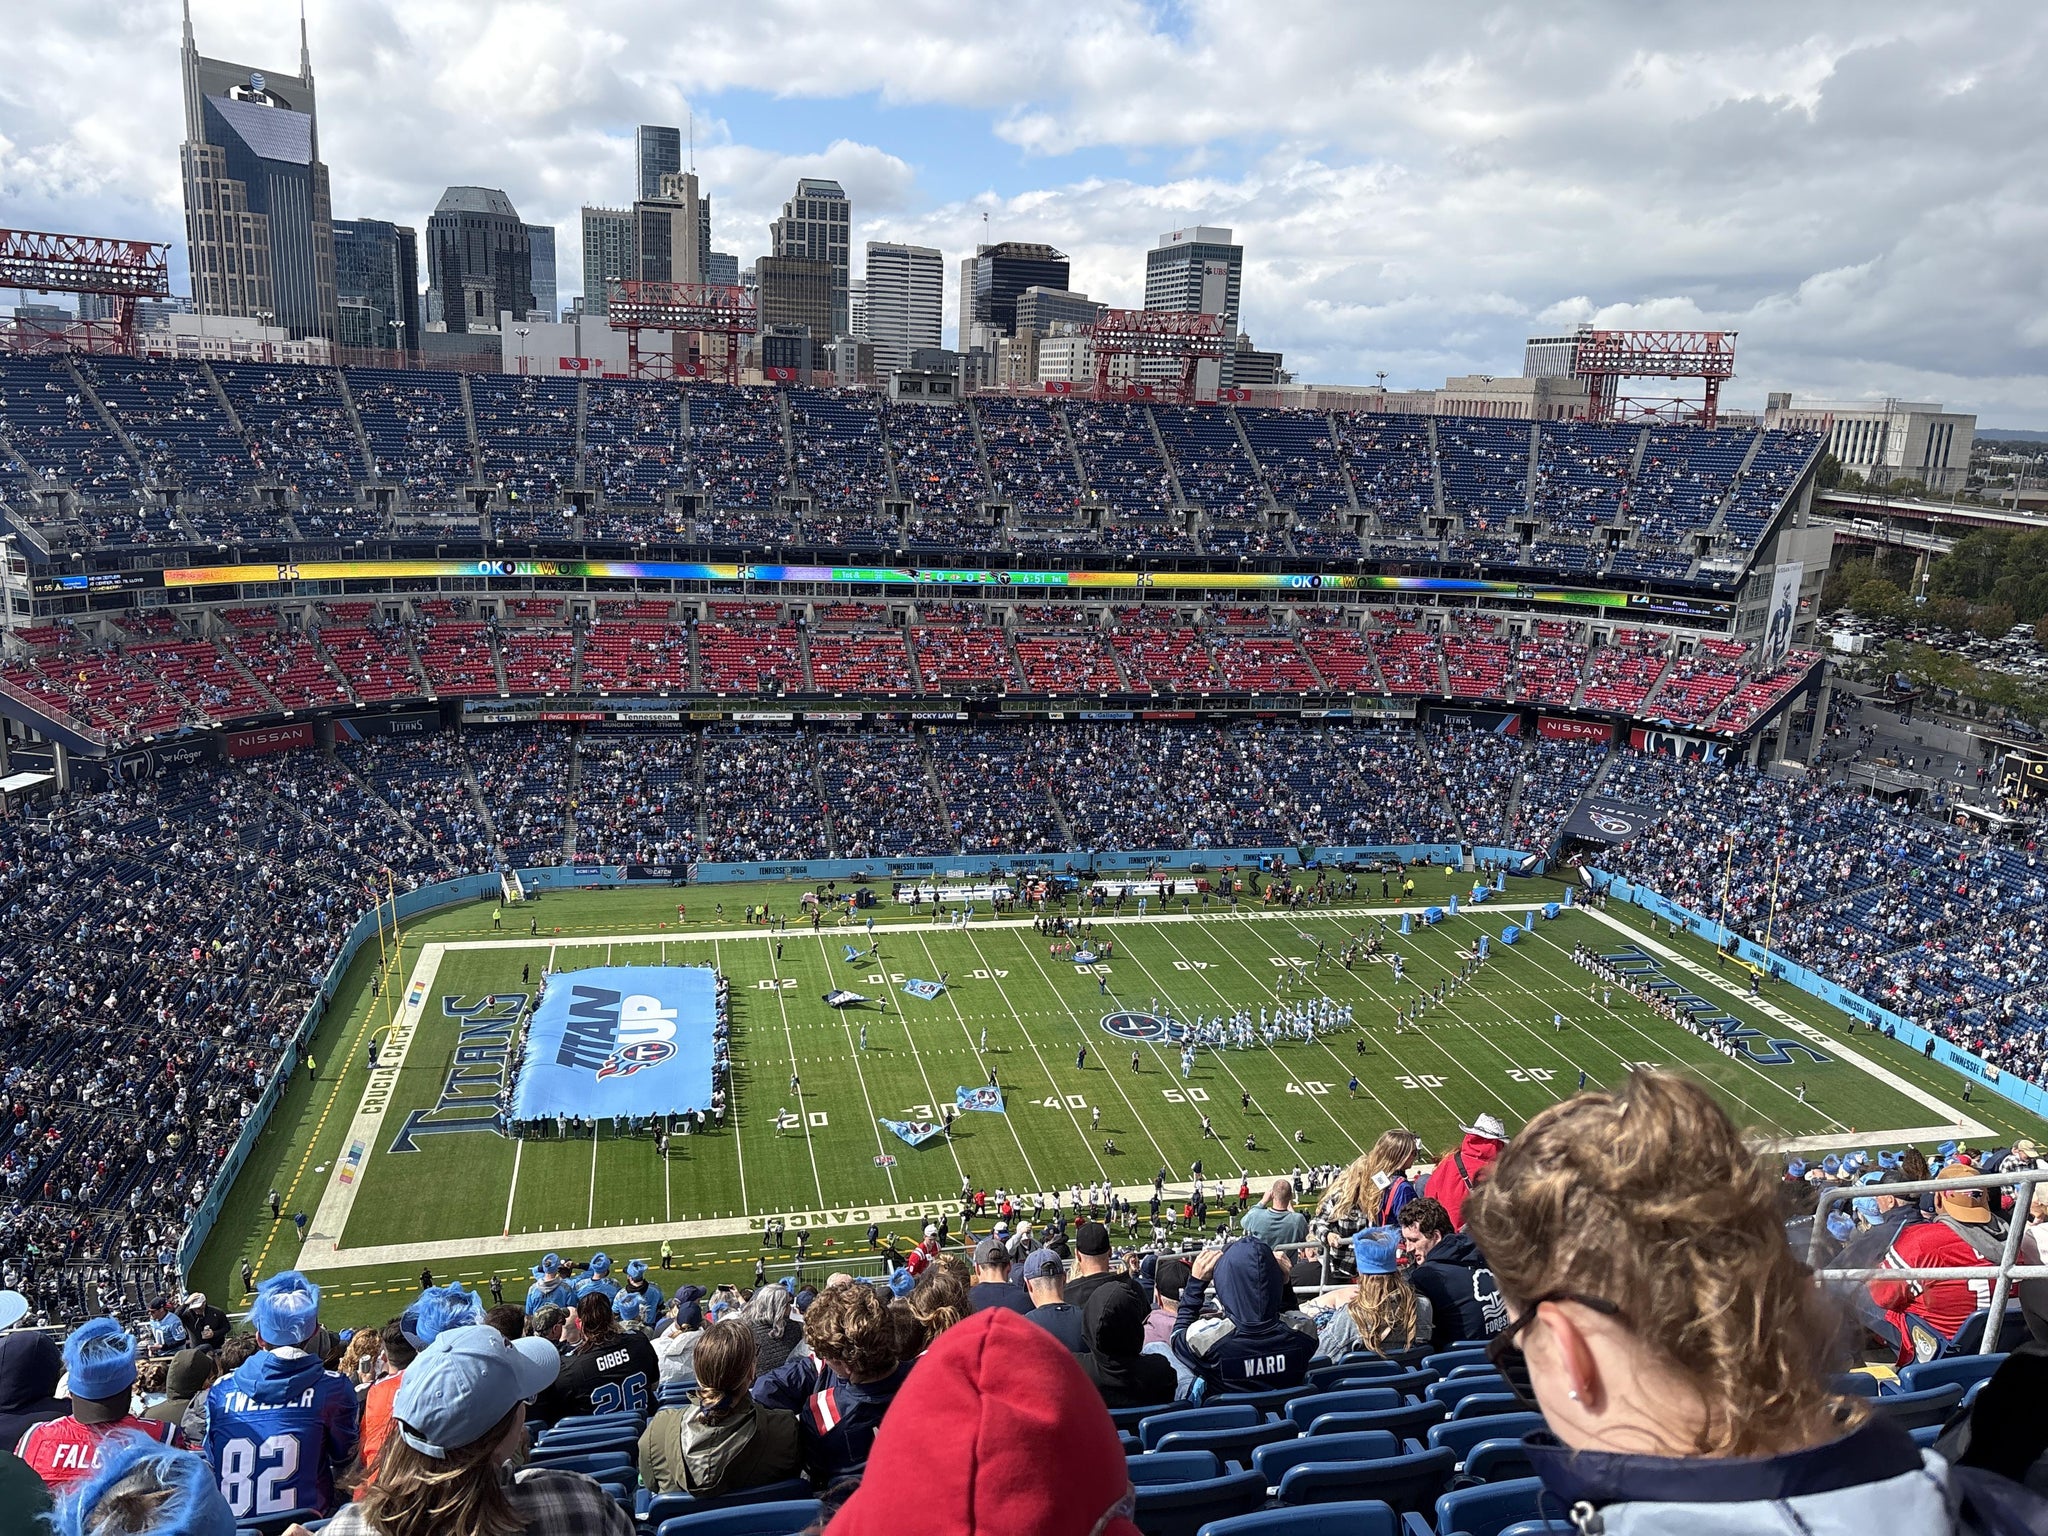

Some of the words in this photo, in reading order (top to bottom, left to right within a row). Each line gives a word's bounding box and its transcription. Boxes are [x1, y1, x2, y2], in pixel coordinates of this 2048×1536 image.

[278, 564, 299, 580] 85
[478, 560, 571, 576] OKONKWO
[737, 564, 756, 580] 85
[936, 572, 944, 581] 0
[966, 573, 974, 582] 0
[1023, 574, 1046, 583] 6:51
[1136, 573, 1154, 588] 85
[1291, 575, 1368, 588] OKONKWO
[35, 584, 53, 592] 11:55
[1516, 584, 1535, 599] 85
[622, 713, 676, 721] Tennessean.
[1443, 714, 1472, 726] TITANS
[389, 719, 423, 733] TITANS
[1546, 721, 1604, 736] NISSAN
[238, 729, 304, 747] NISSAN
[173, 748, 202, 764] Kroger
[1589, 804, 1649, 820] NISSAN
[1576, 833, 1606, 844] NISSAN
[887, 862, 915, 871] TENNESSEE
[916, 861, 934, 870] TOUGH
[1010, 859, 1036, 867] TENNESSEE
[759, 866, 786, 876] TENNESSEE
[1074, 964, 1113, 974] 50
[1172, 960, 1209, 971] 40
[1268, 956, 1307, 967] 30
[867, 973, 907, 984] 30
[972, 969, 1009, 980] 40
[758, 978, 798, 990] 20
[1602, 944, 1834, 1065] TITANS
[1691, 962, 1741, 994] TAKES
[1739, 992, 1772, 1012] ALL
[1776, 1012, 1802, 1028] OF
[1802, 1028, 1832, 1045] US
[1839, 993, 1866, 1015] TENNESSEE
[617, 994, 678, 1044] UP
[556, 985, 622, 1072] TITAN
[361, 1062, 399, 1115] CRUCIAL
[383, 1025, 413, 1058] CATCH
[1949, 1051, 1980, 1074] TENNESSEE
[387, 992, 530, 1155] TITANS
[1504, 1067, 1554, 1082] 20
[1284, 1081, 1330, 1096] 40
[1393, 1074, 1446, 1089] 30
[1043, 1094, 1088, 1110] 40
[1161, 1087, 1211, 1103] 50
[912, 1102, 961, 1120] 30
[780, 1111, 829, 1129] 20
[175, 1325, 184, 1335] 10
[596, 1348, 630, 1372] GIBBS
[1243, 1354, 1286, 1378] WARD
[590, 1371, 648, 1416] 26
[220, 1433, 301, 1519] 82
